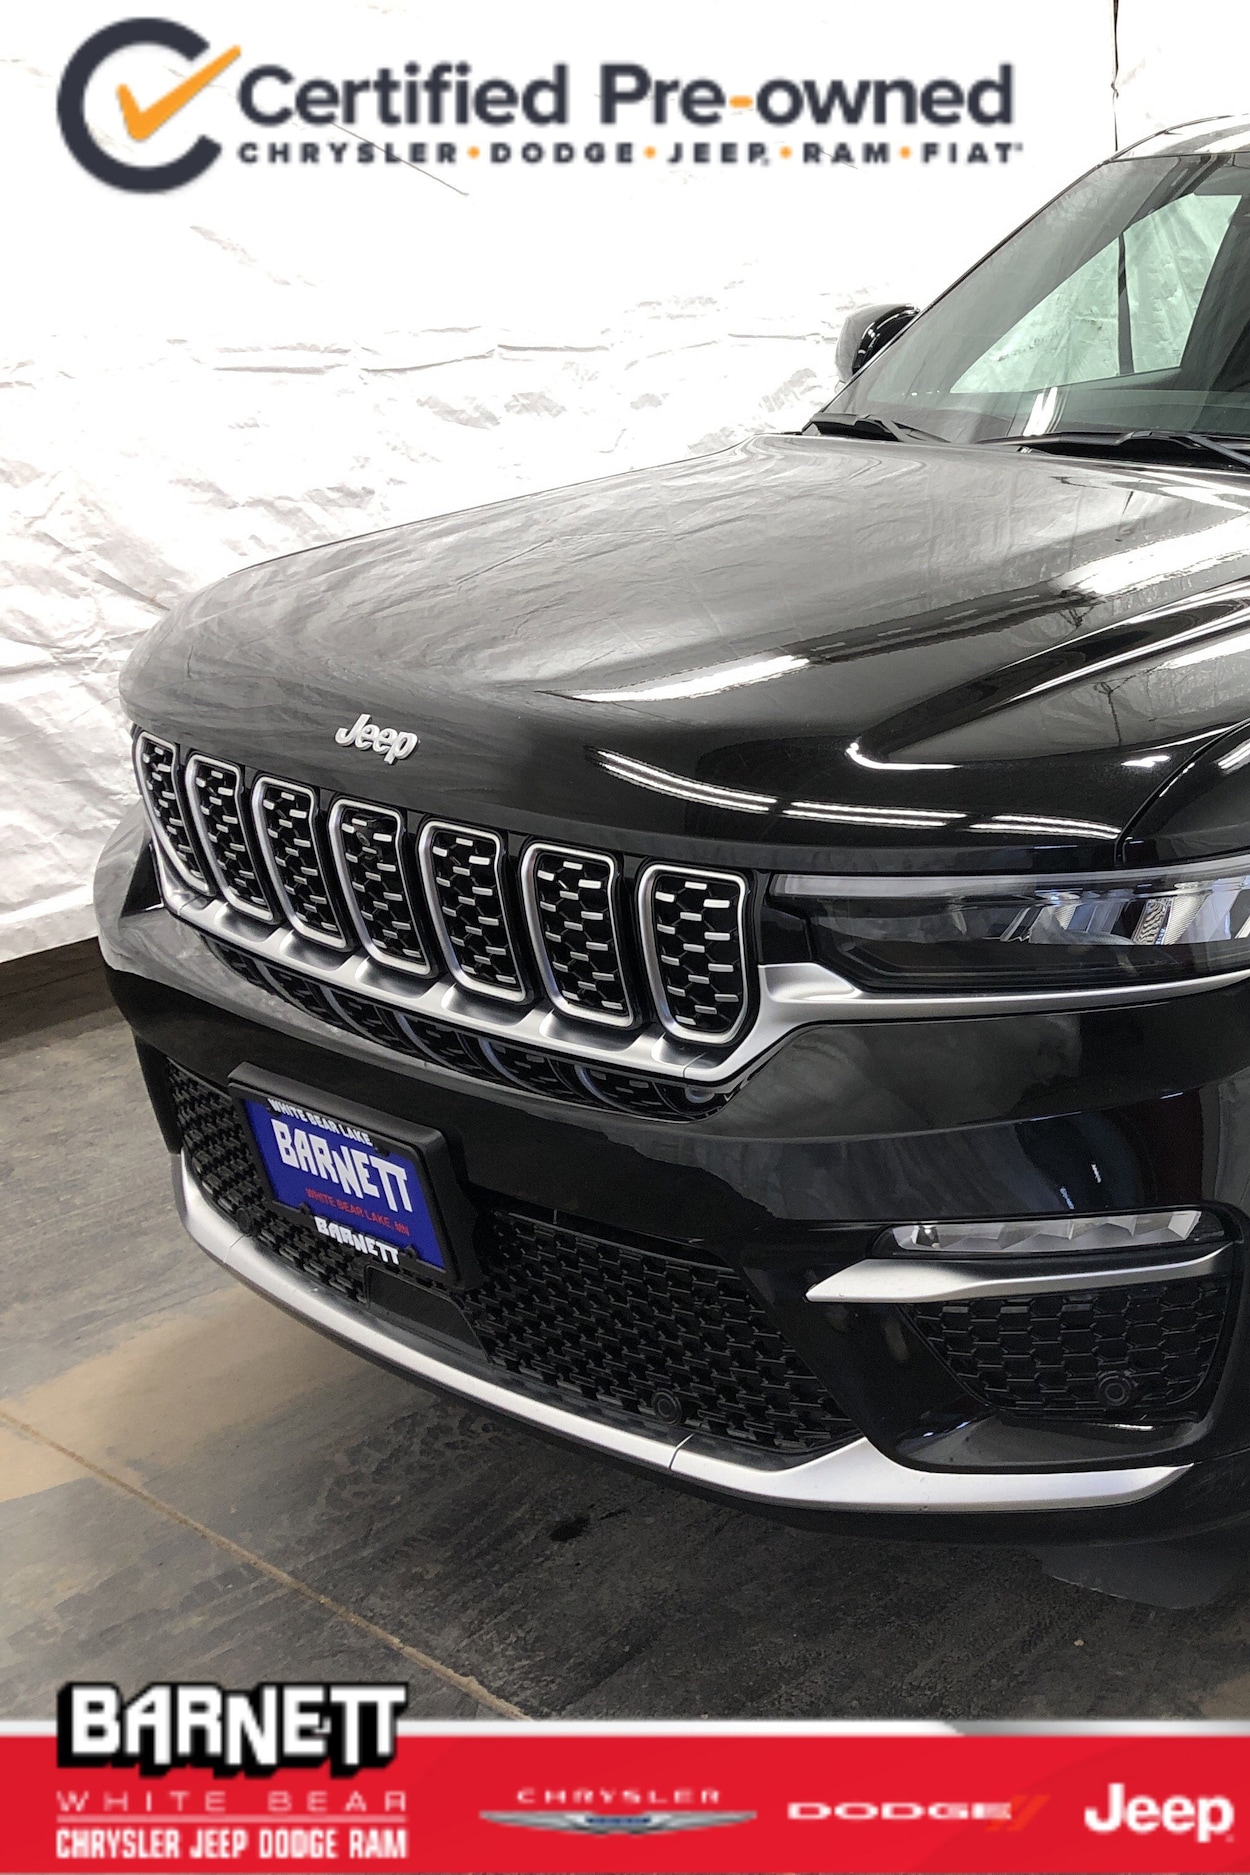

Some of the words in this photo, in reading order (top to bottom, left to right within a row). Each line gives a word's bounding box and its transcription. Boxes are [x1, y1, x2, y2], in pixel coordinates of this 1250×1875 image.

[334, 713, 418, 765] Jeep
[267, 1097, 308, 1123] WHITE
[306, 1111, 341, 1135] BEAR
[338, 1123, 374, 1147] LAKE
[270, 1118, 413, 1213] BARNETT
[305, 1188, 337, 1208] WHITE
[336, 1199, 364, 1218] BEAR
[313, 1215, 400, 1265] BARNETT
